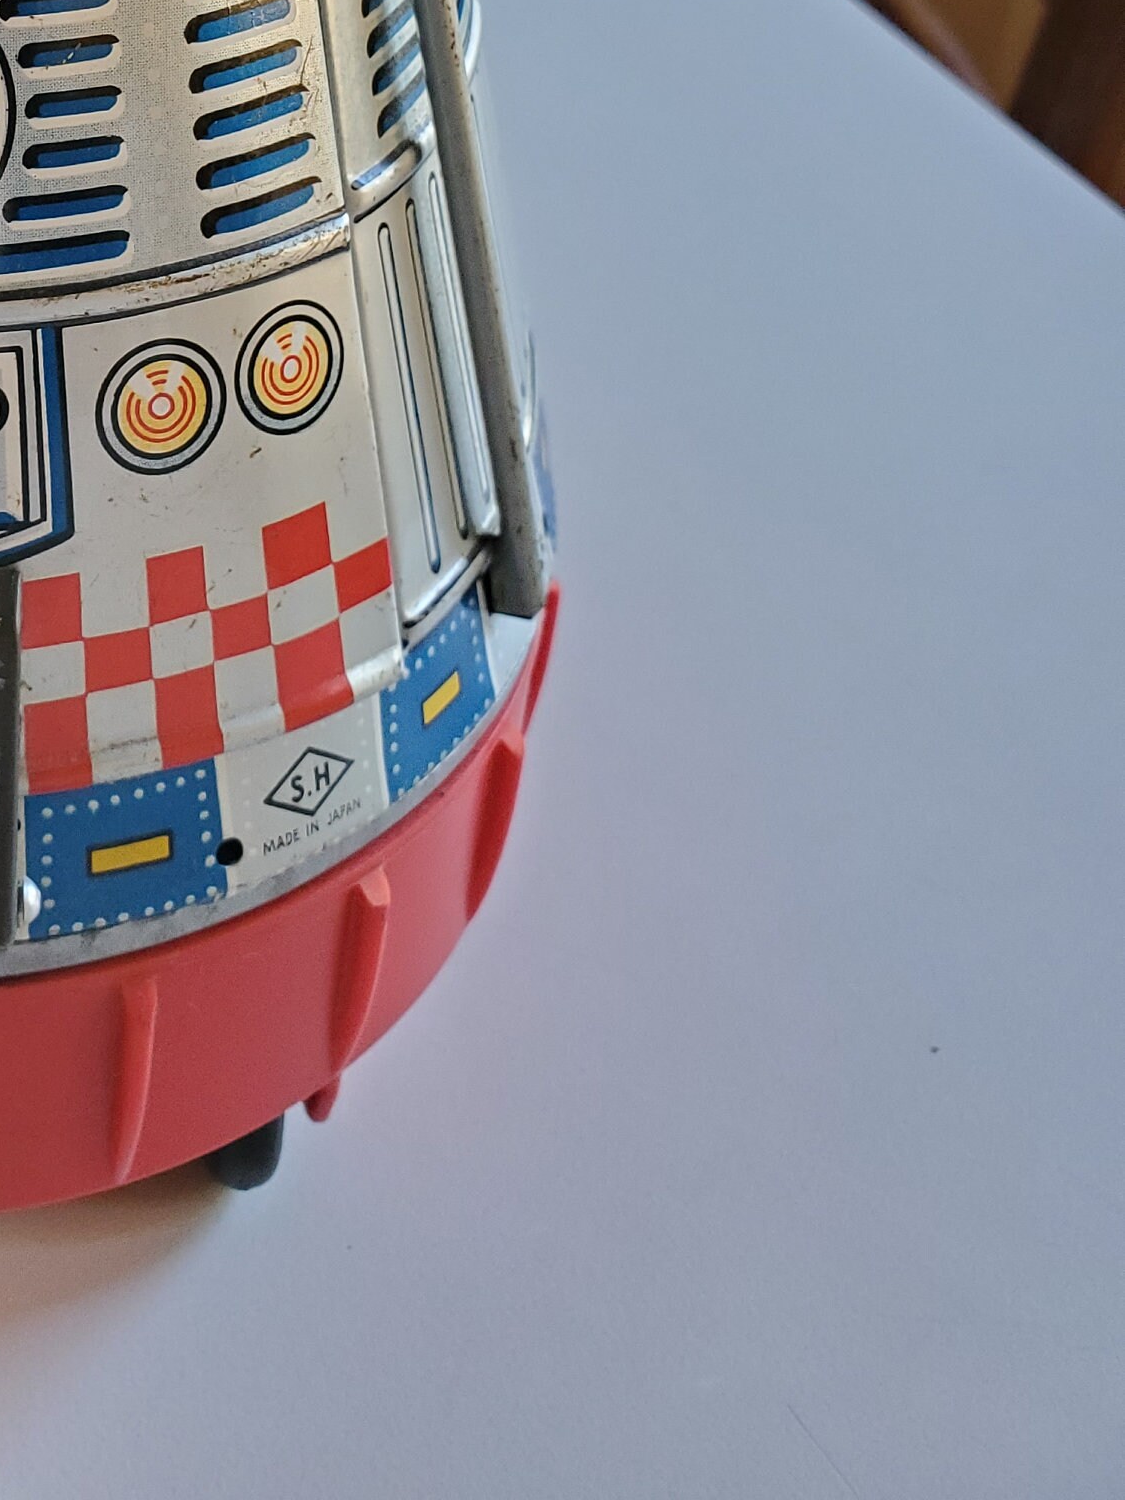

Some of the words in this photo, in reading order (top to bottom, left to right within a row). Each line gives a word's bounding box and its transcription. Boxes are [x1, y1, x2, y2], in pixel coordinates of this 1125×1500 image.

[262, 827, 301, 856] MADE
[306, 819, 320, 837] IN
[327, 796, 362, 826] JAPAN
